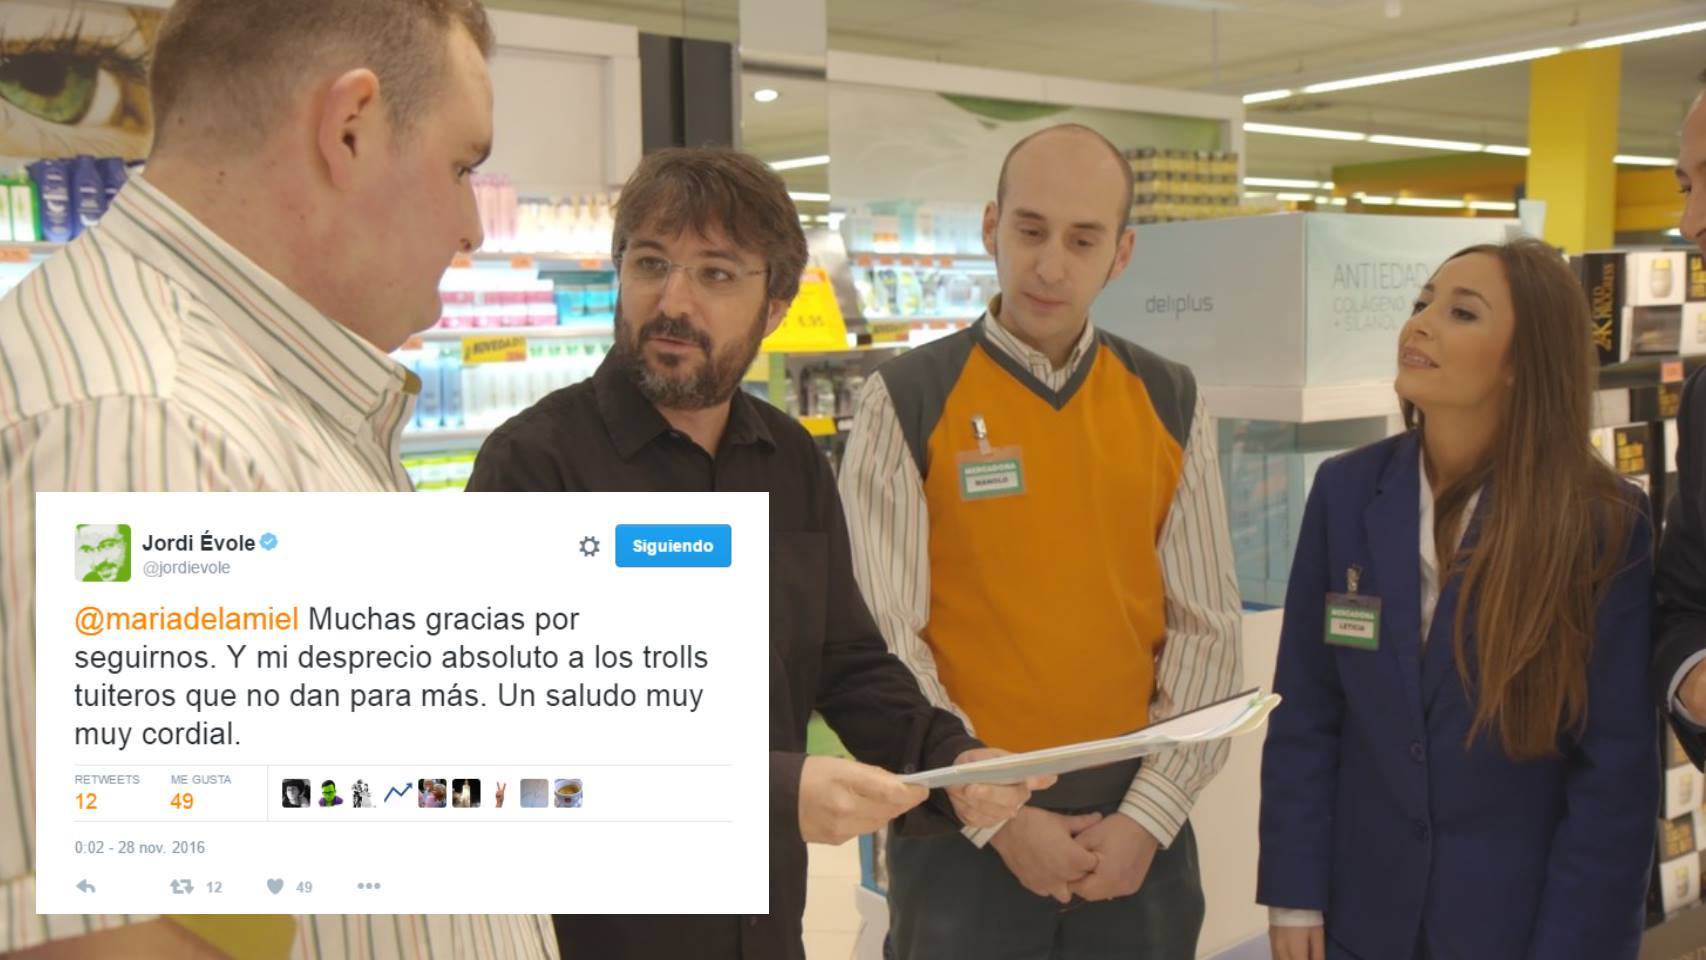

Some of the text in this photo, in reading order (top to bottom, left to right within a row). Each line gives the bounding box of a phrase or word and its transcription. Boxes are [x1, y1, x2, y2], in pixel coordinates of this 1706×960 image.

[1331, 262, 1429, 289] ANTIEDAD
[1145, 294, 1214, 320] deliplus
[964, 462, 1017, 475] MERCADONA
[975, 476, 1009, 487] MANOLO
